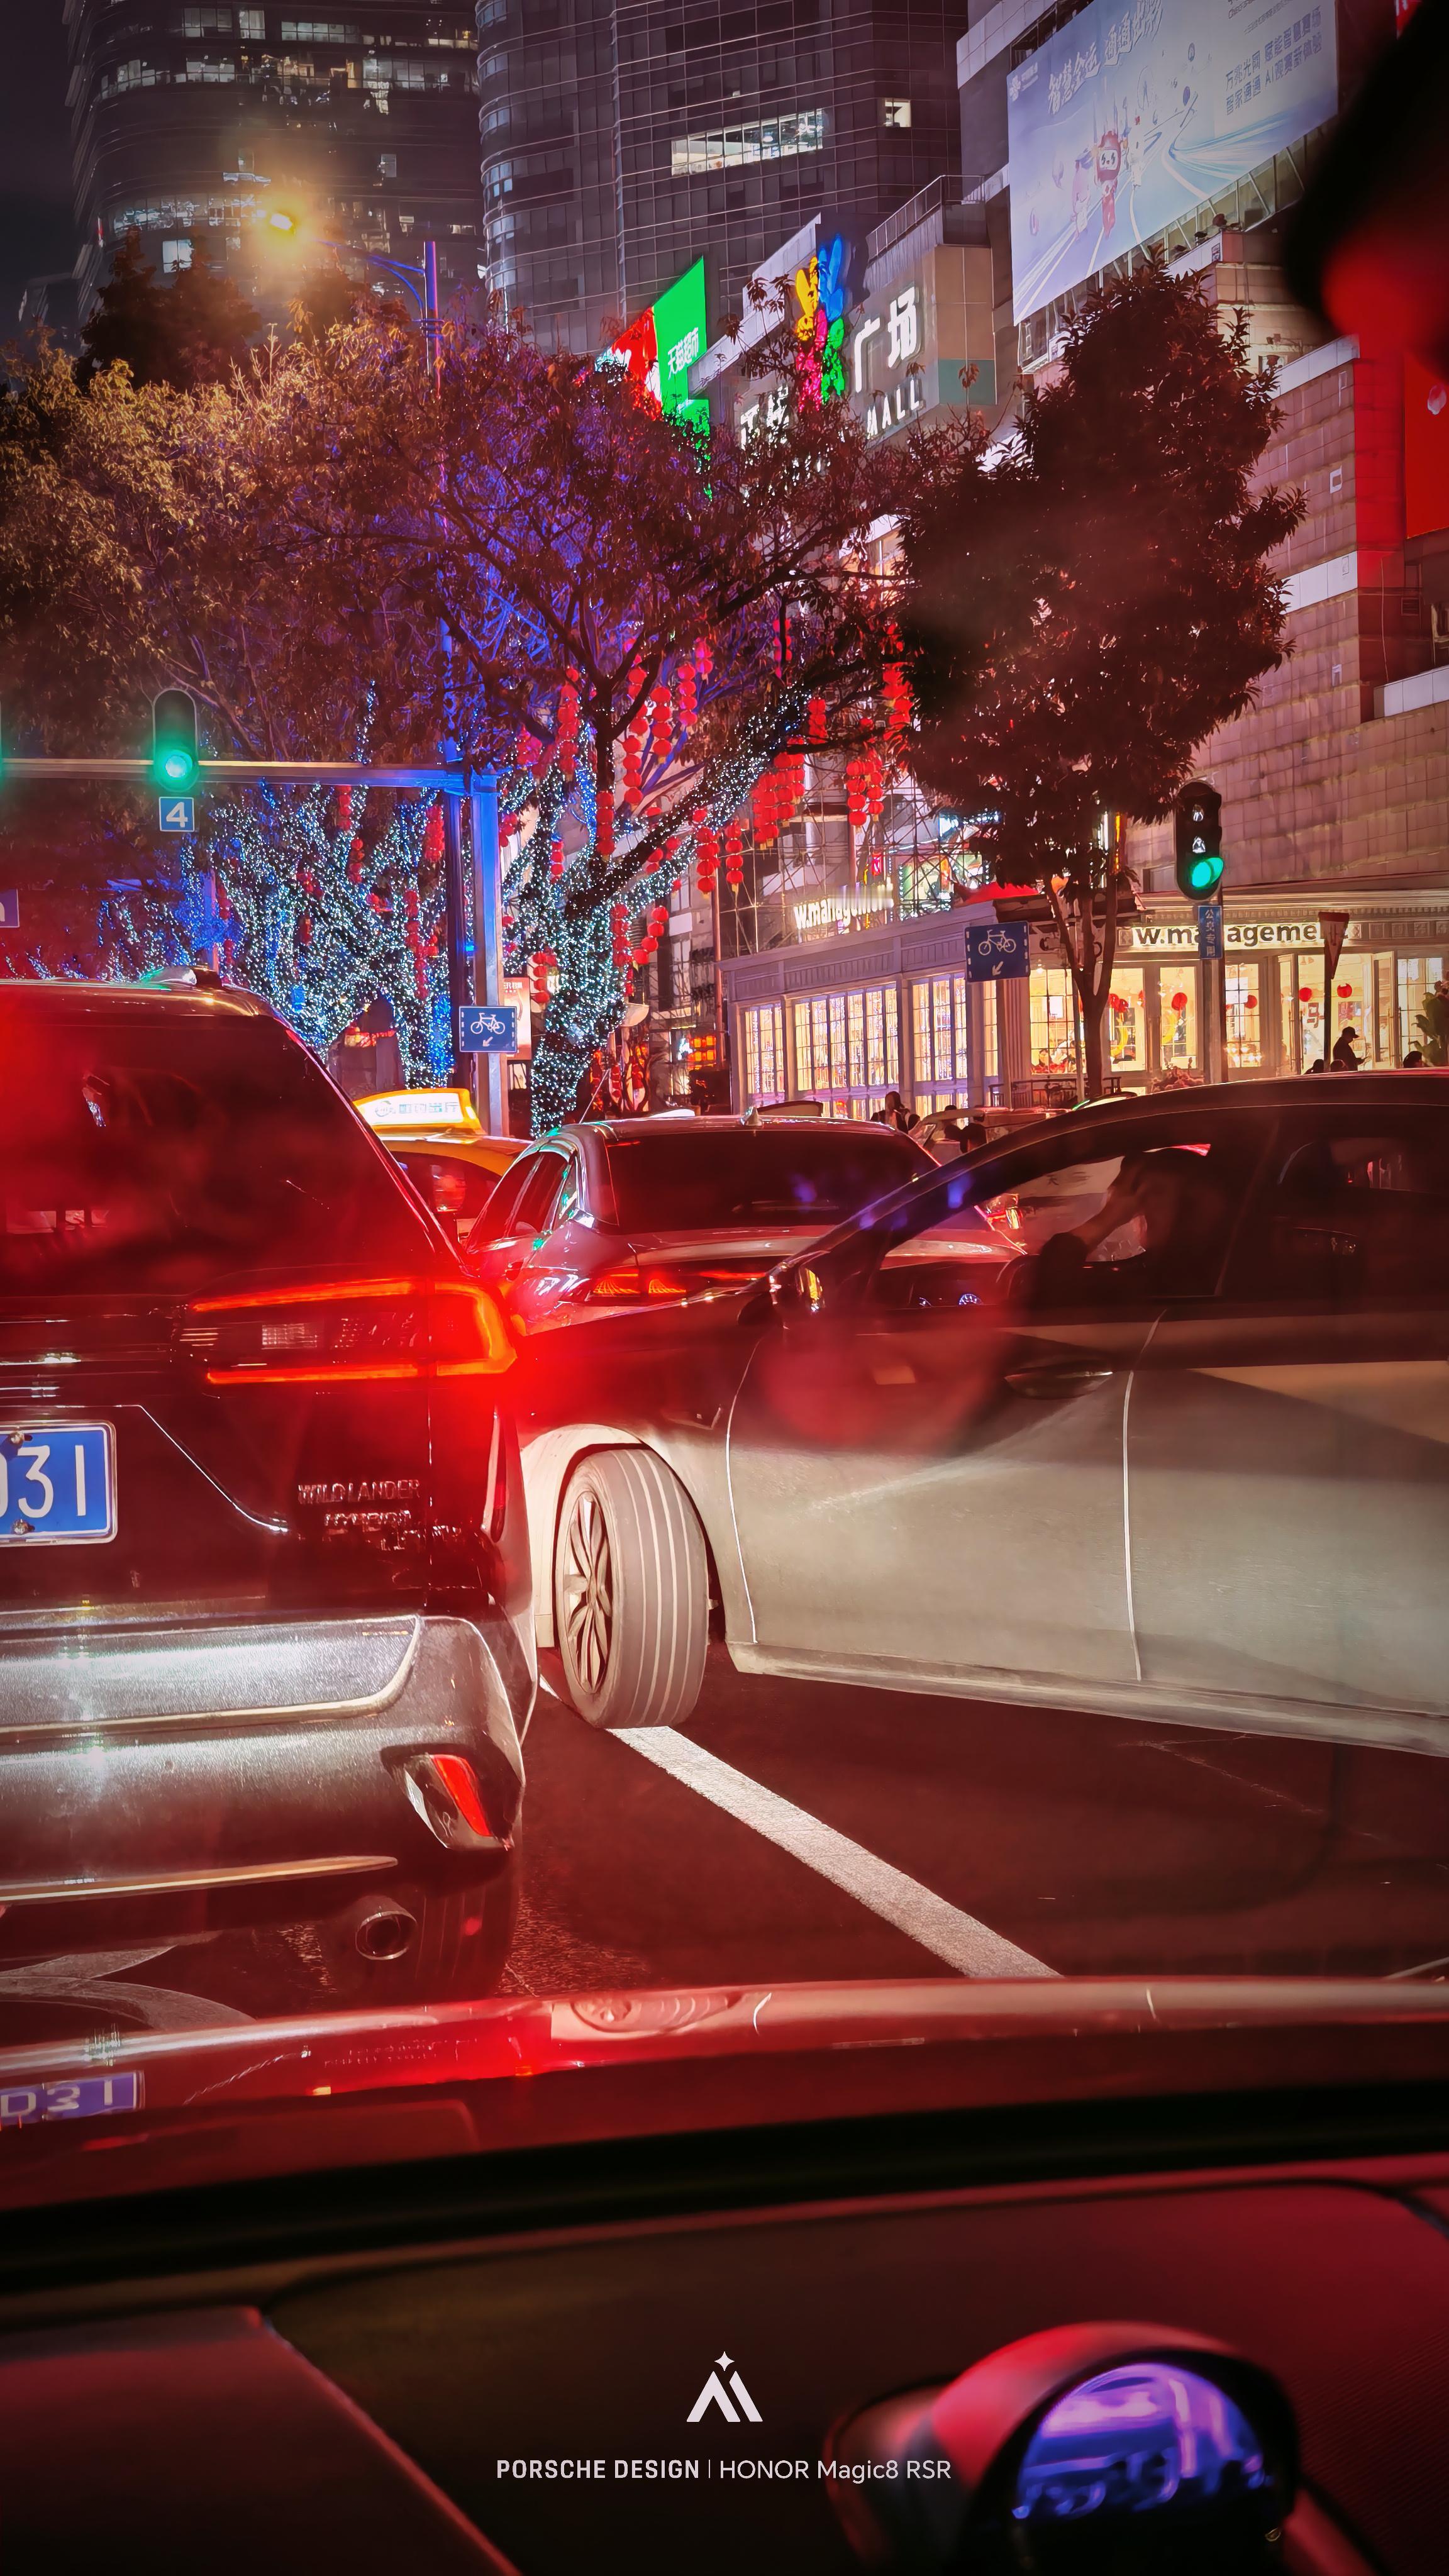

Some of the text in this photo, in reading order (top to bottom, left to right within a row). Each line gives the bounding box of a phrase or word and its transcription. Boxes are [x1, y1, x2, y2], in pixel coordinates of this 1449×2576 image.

[854, 286, 917, 393] 广场
[867, 379, 919, 439] MALL
[166, 802, 188, 828] 4
[1136, 924, 1348, 947] w.mageme
